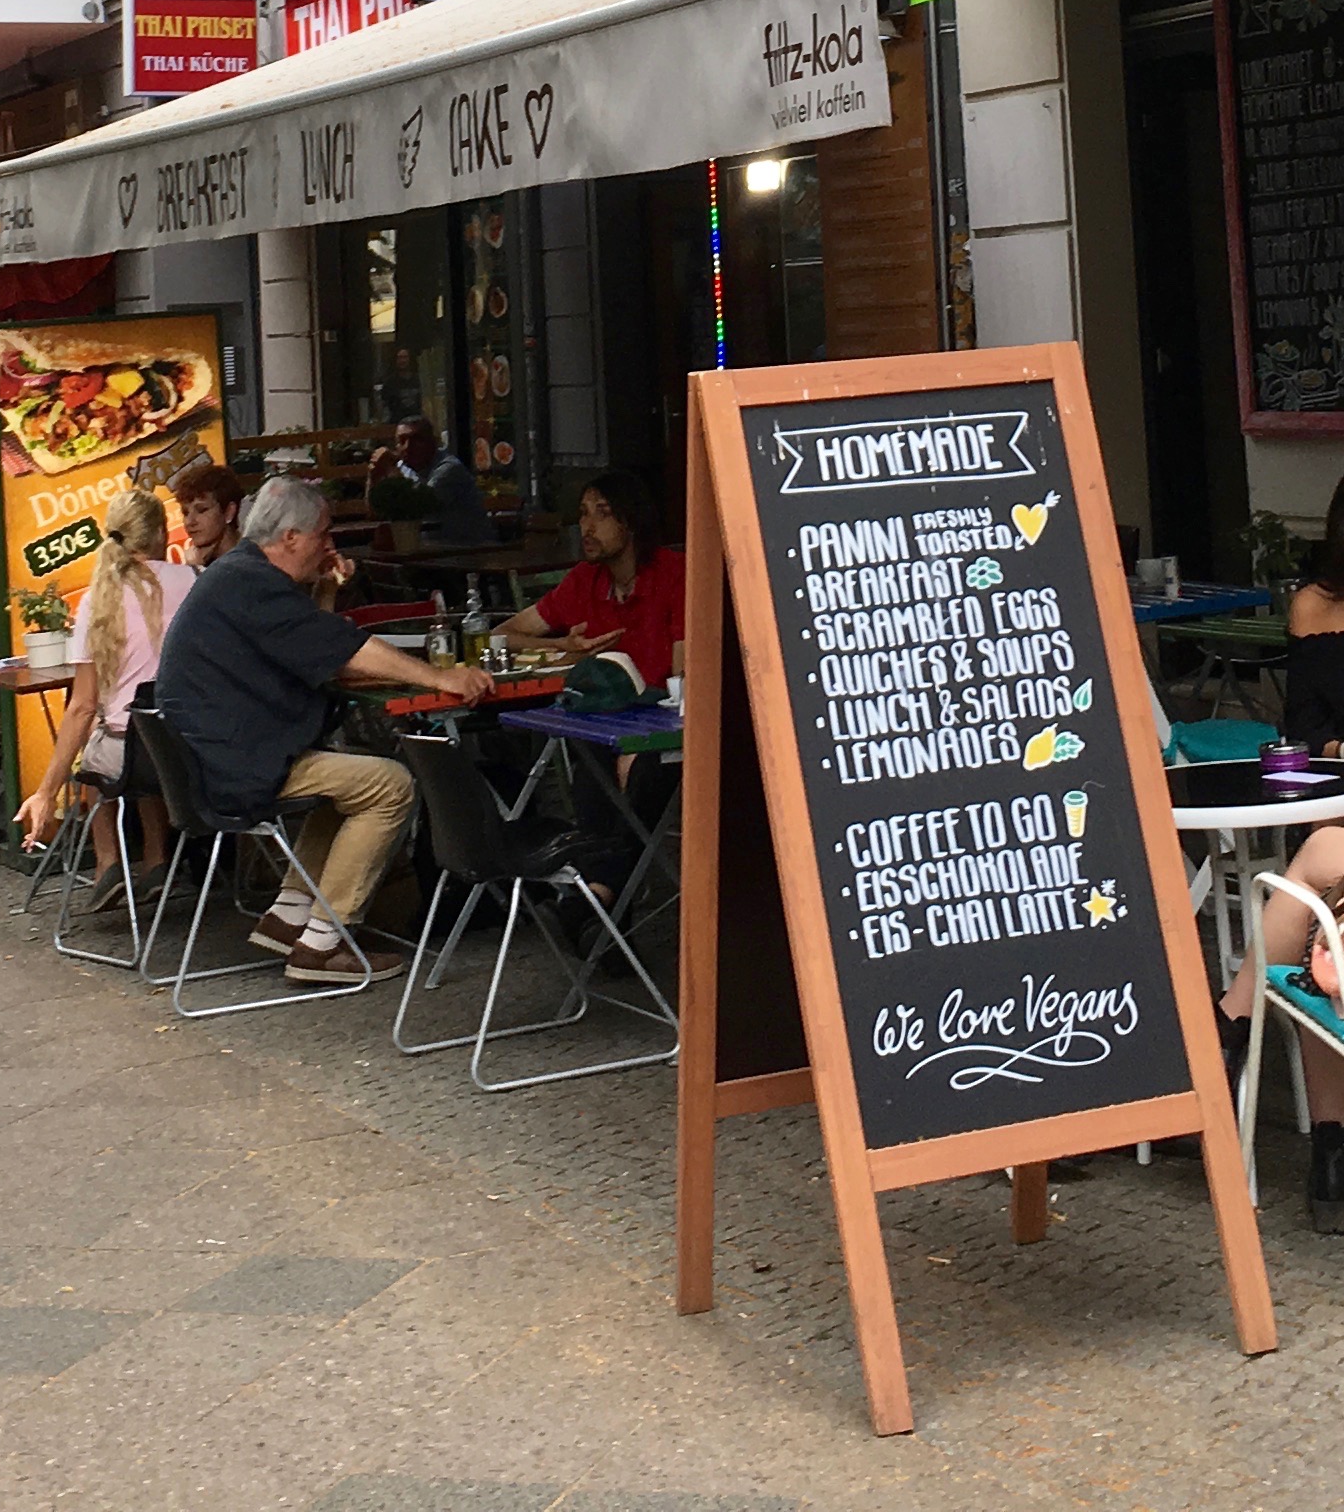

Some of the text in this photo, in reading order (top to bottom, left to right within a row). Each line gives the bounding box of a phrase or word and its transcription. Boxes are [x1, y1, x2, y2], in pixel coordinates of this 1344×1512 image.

[135, 15, 255, 39] THAI PHISET
[816, 81, 866, 119] koffein
[157, 84, 513, 233] BREAKFAST LUNCH CAKE
[816, 424, 1003, 482] HOMEMADE
[27, 472, 133, 529] Döner
[31, 525, 97, 570] 3,50€
[799, 506, 993, 572] PANINI FRESHLY
[914, 524, 1014, 557] TOASTED
[805, 556, 965, 612] BREAKFAST
[813, 587, 1062, 652] SCRAMBLED EGGS
[819, 630, 1075, 697] QUICHES & SOUPS
[828, 675, 1074, 742] LUNCH & SALADS
[835, 724, 1021, 785] LEMONADES
[845, 794, 1058, 869] COFFEE TO GO
[855, 842, 1089, 913] EISSCHOKOLADE
[1006, 886, 1085, 938] LATTE
[873, 974, 1139, 1057] We love Vegans
